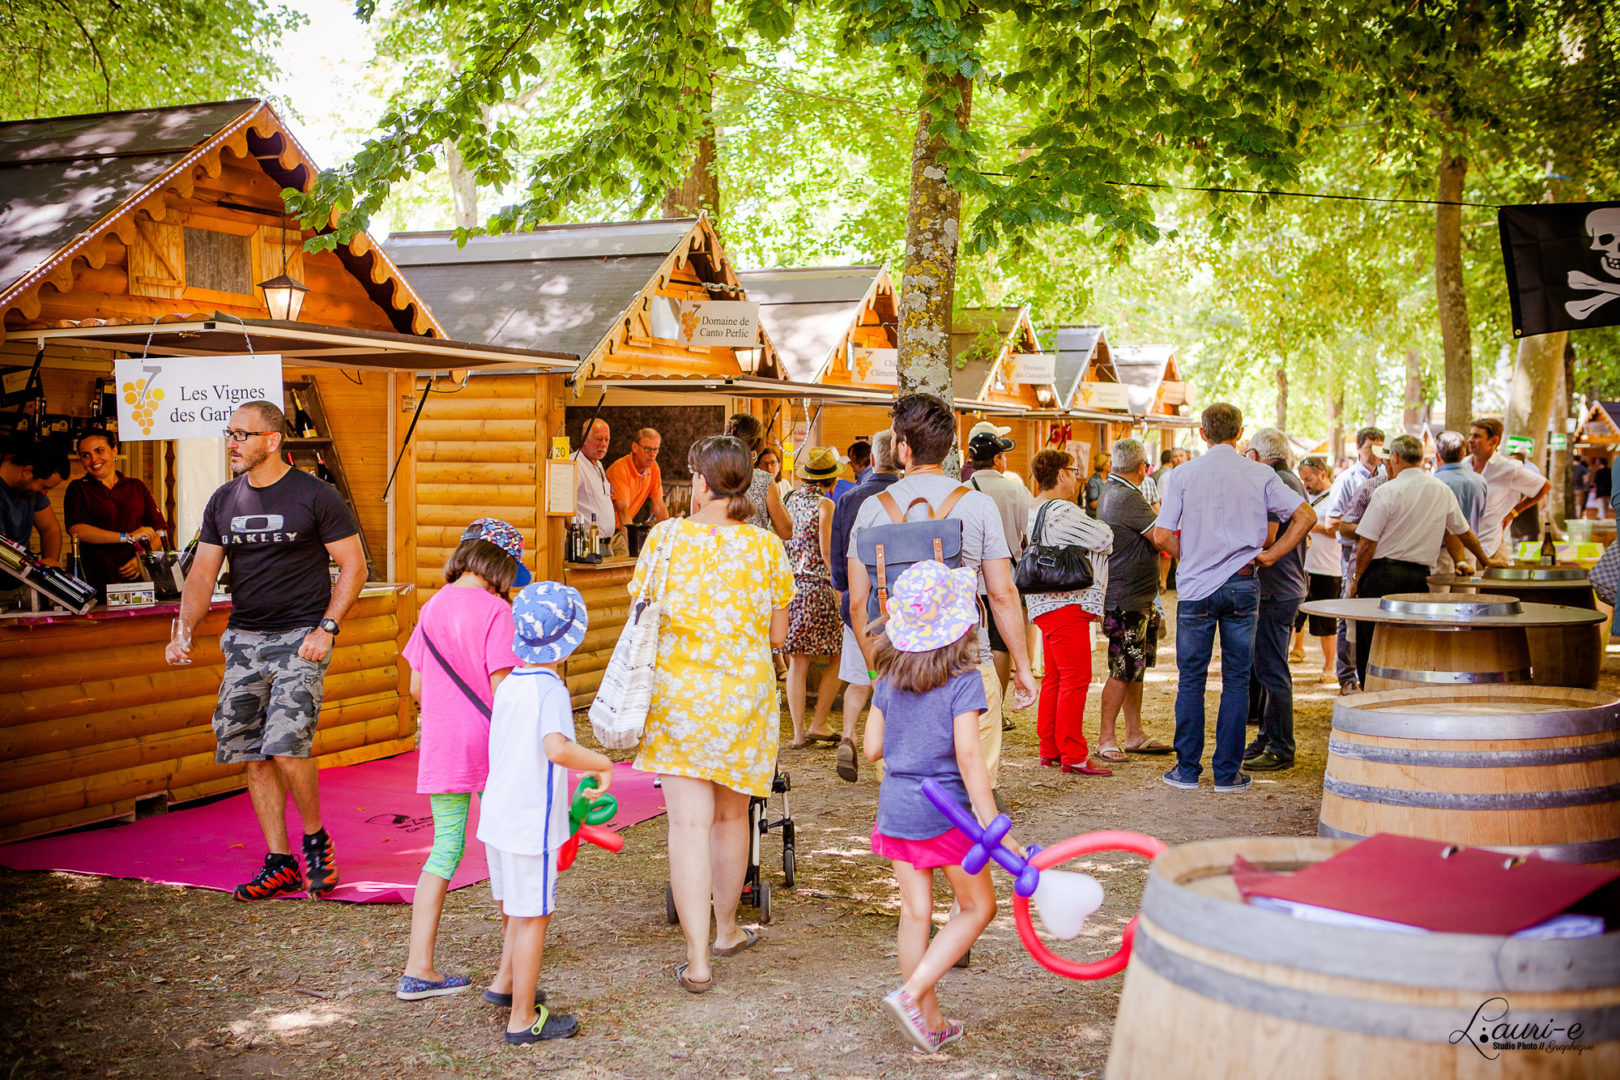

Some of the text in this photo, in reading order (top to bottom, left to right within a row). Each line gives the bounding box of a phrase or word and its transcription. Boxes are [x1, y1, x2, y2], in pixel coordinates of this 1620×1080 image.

[692, 304, 702, 321] 7
[702, 316, 750, 326] Domaine de
[699, 327, 749, 338] Canto Perlic
[142, 365, 162, 402] 7
[180, 384, 266, 404] Les Vignes
[170, 407, 196, 423] des
[555, 447, 565, 458] 20
[221, 532, 298, 545] OAKLEY
